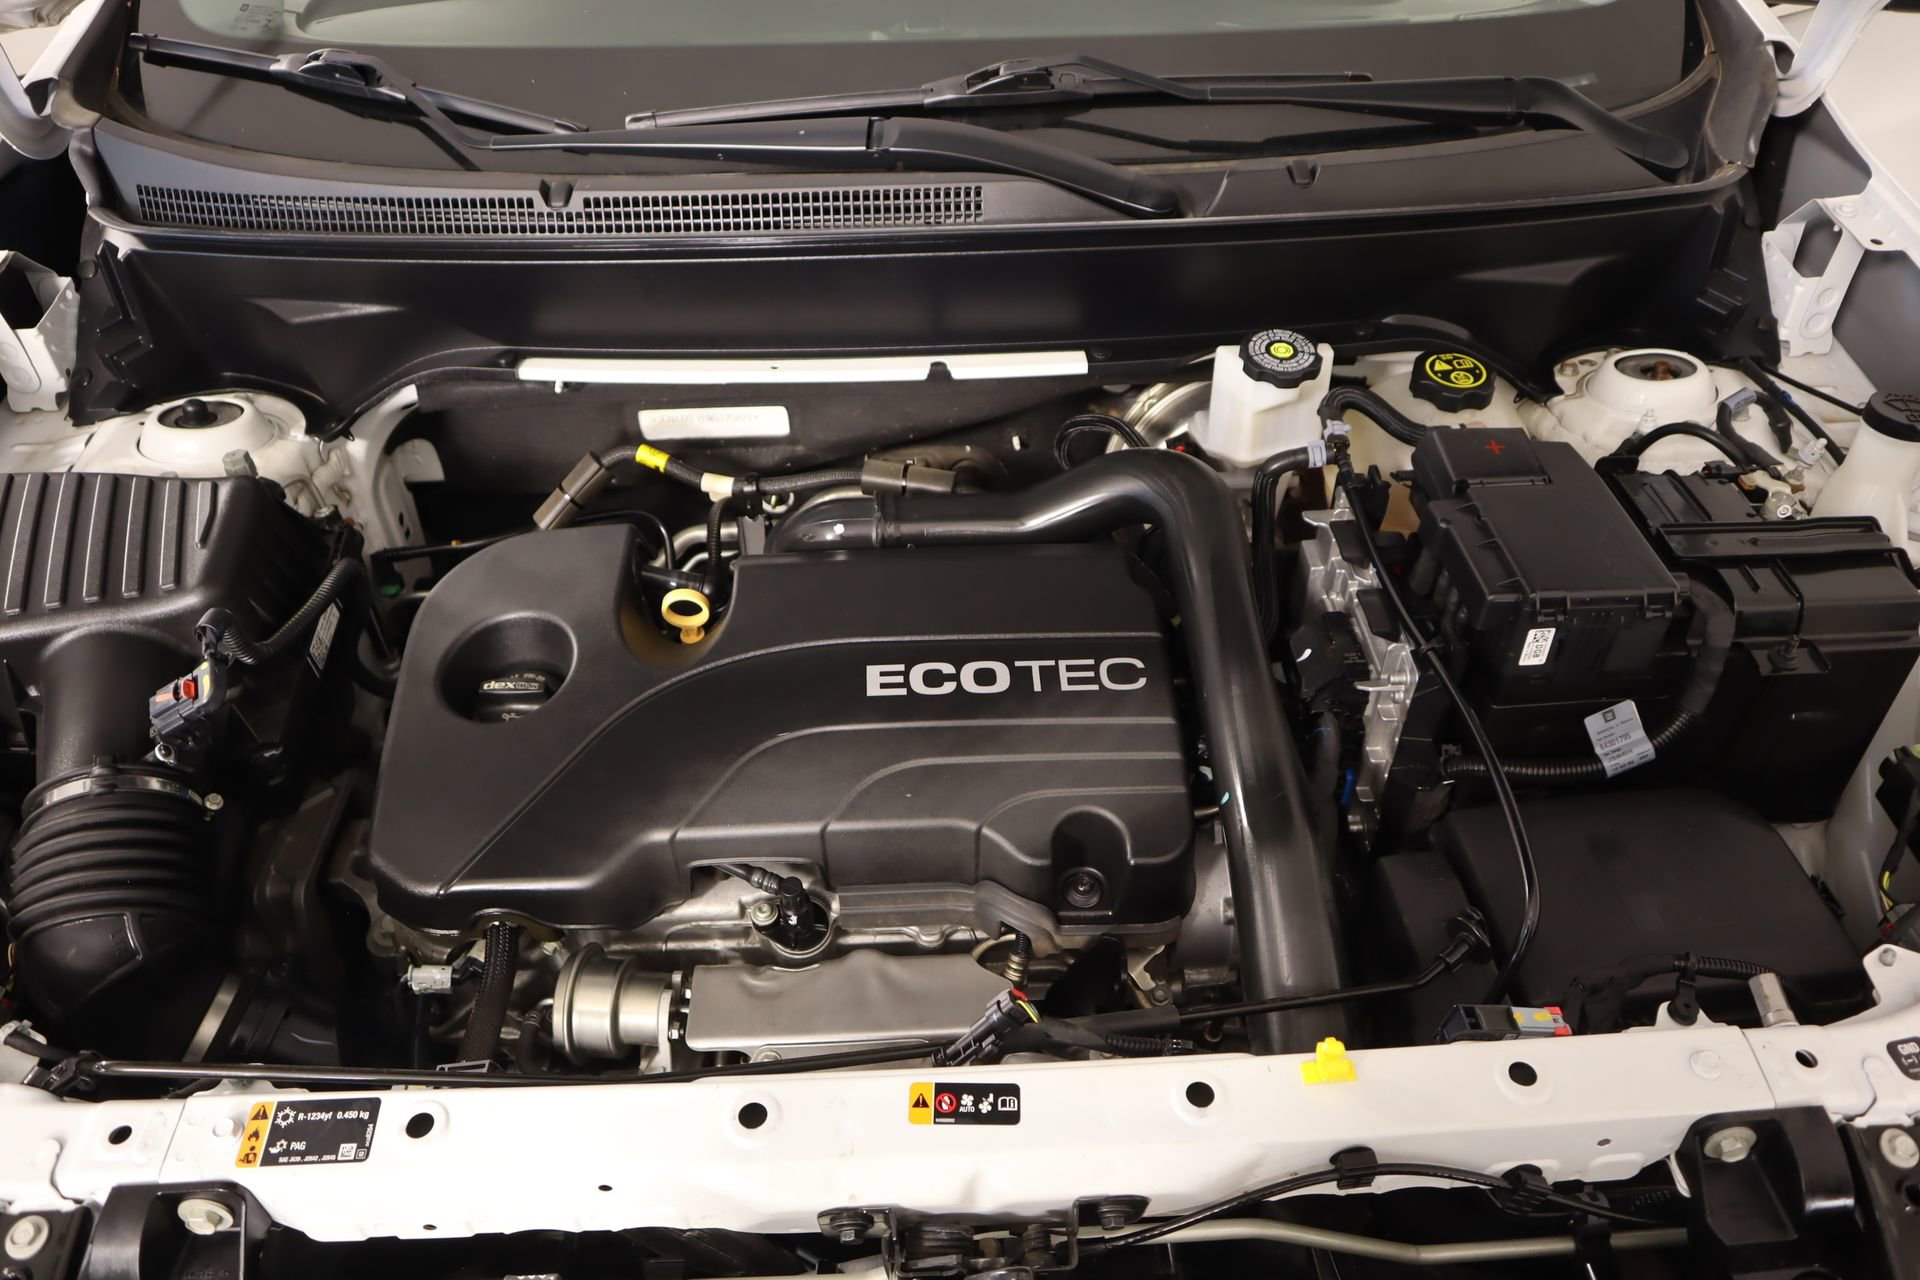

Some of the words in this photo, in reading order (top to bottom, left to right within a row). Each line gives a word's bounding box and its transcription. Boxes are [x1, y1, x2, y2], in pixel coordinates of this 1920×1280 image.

[866, 657, 1148, 697] ECOTEC
[297, 1111, 333, 1122] R-1234yf
[336, 1110, 359, 1120] 0.450
[359, 1110, 370, 1120] kg
[290, 1141, 307, 1151] PAG
